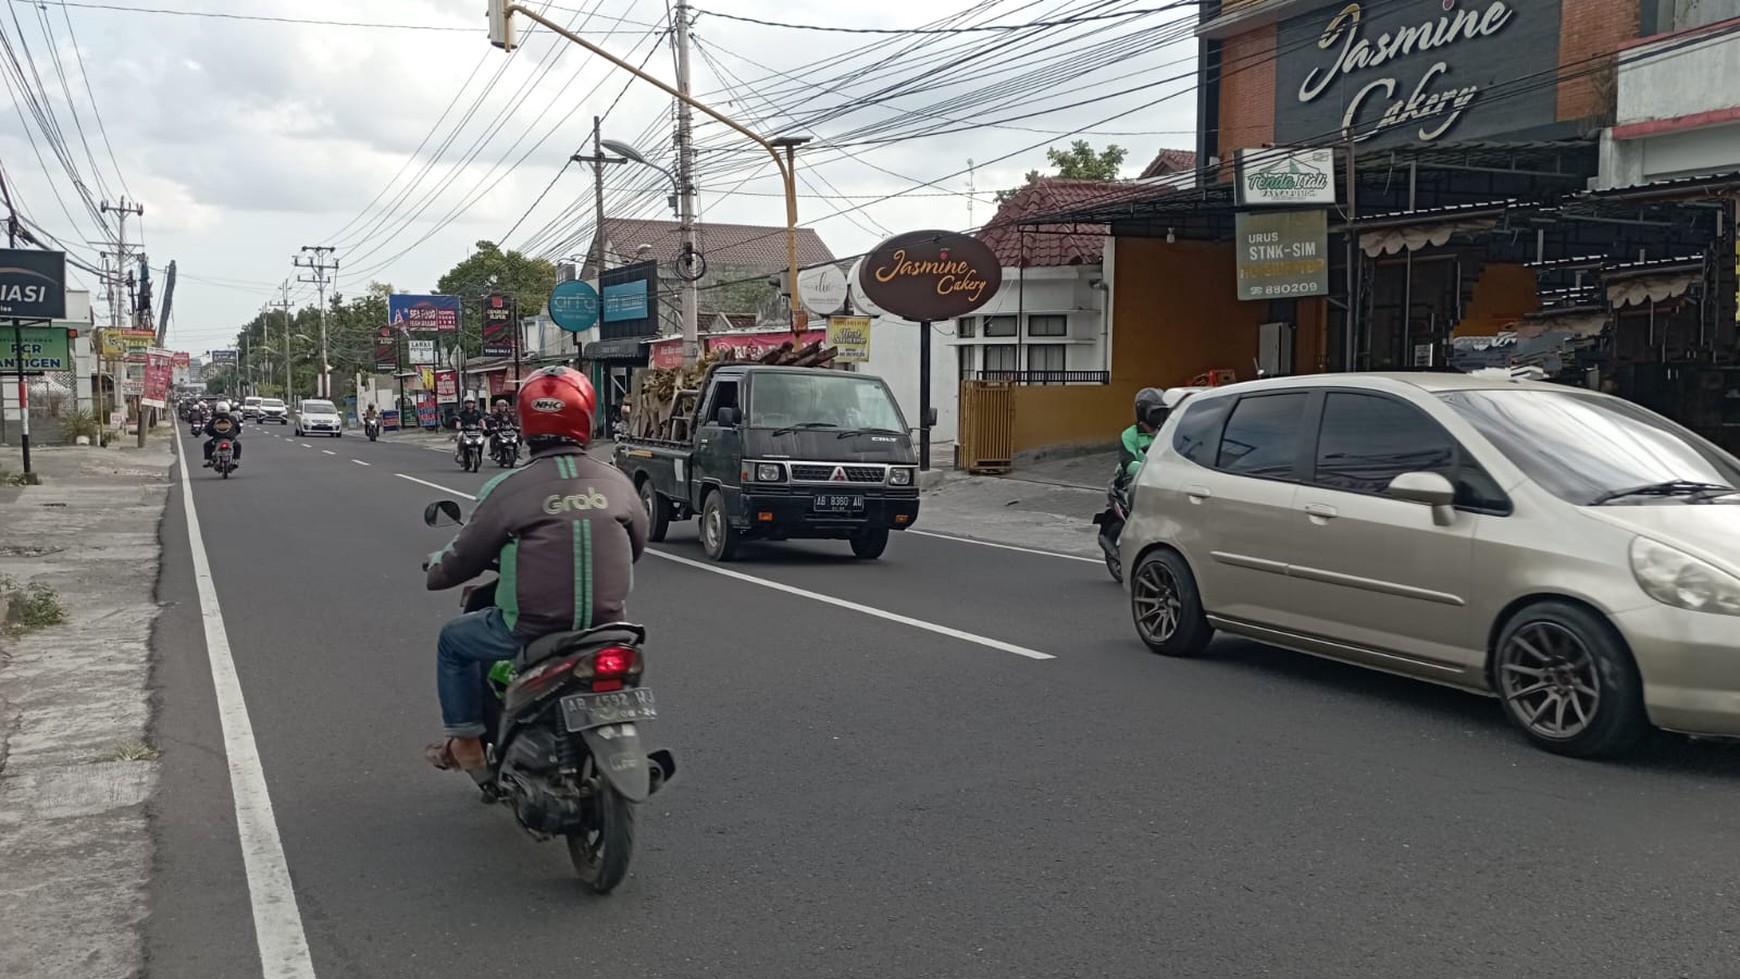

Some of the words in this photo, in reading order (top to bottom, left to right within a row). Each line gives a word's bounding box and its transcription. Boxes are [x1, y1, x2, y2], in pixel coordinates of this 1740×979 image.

[1298, 0, 1512, 102] Jasmine
[1341, 61, 1478, 141] Cakery
[1248, 172, 1295, 190] Tenda
[1294, 172, 1328, 190] Itali
[1248, 232, 1279, 244] URUS
[1249, 241, 1317, 261] STNK-SIM
[875, 249, 968, 282] Jasmine
[937, 269, 987, 302] Cakery
[1265, 282, 1318, 295] 880209
[535, 401, 561, 409] NHC
[543, 487, 609, 515] Grab
[816, 495, 826, 506] AB
[567, 697, 587, 713] AB
